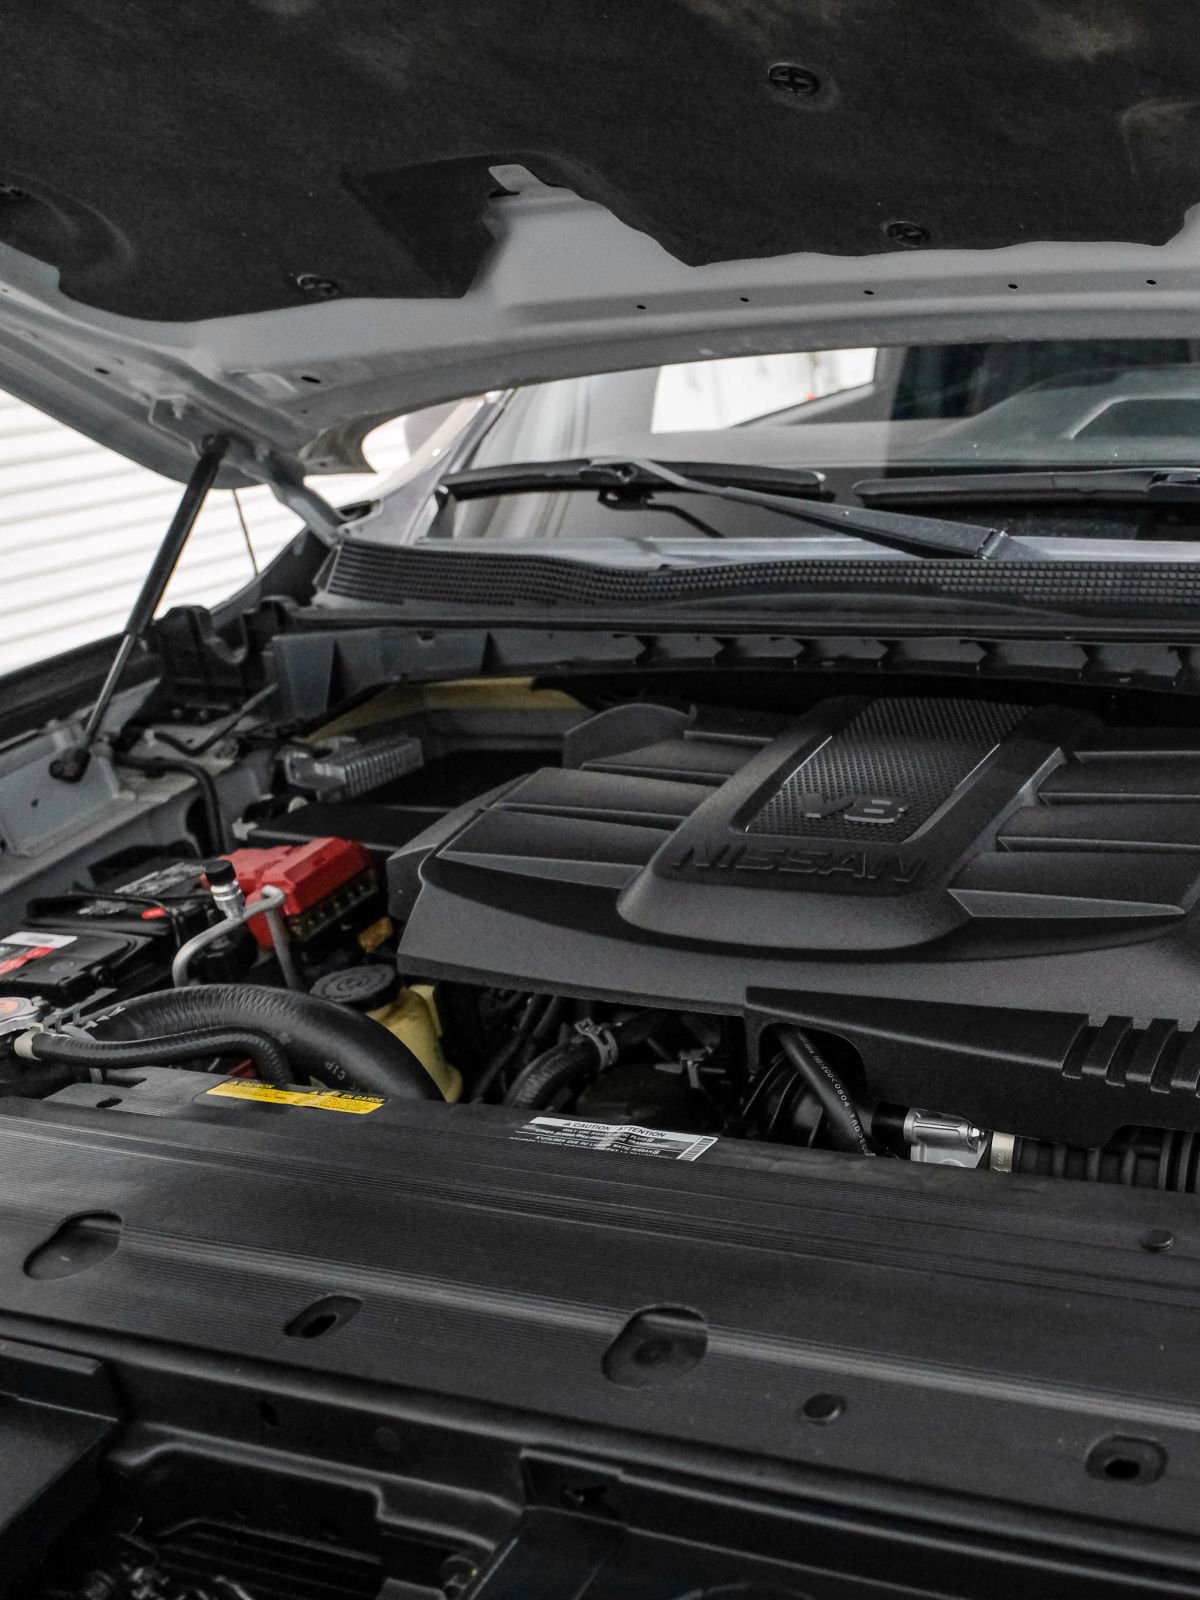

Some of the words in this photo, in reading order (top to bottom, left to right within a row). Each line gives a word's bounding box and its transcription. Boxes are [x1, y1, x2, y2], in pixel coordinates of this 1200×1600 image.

[672, 843, 929, 882] NISSAN
[573, 1123, 612, 1131] CAUTION
[617, 1126, 666, 1137] ATTENTION
